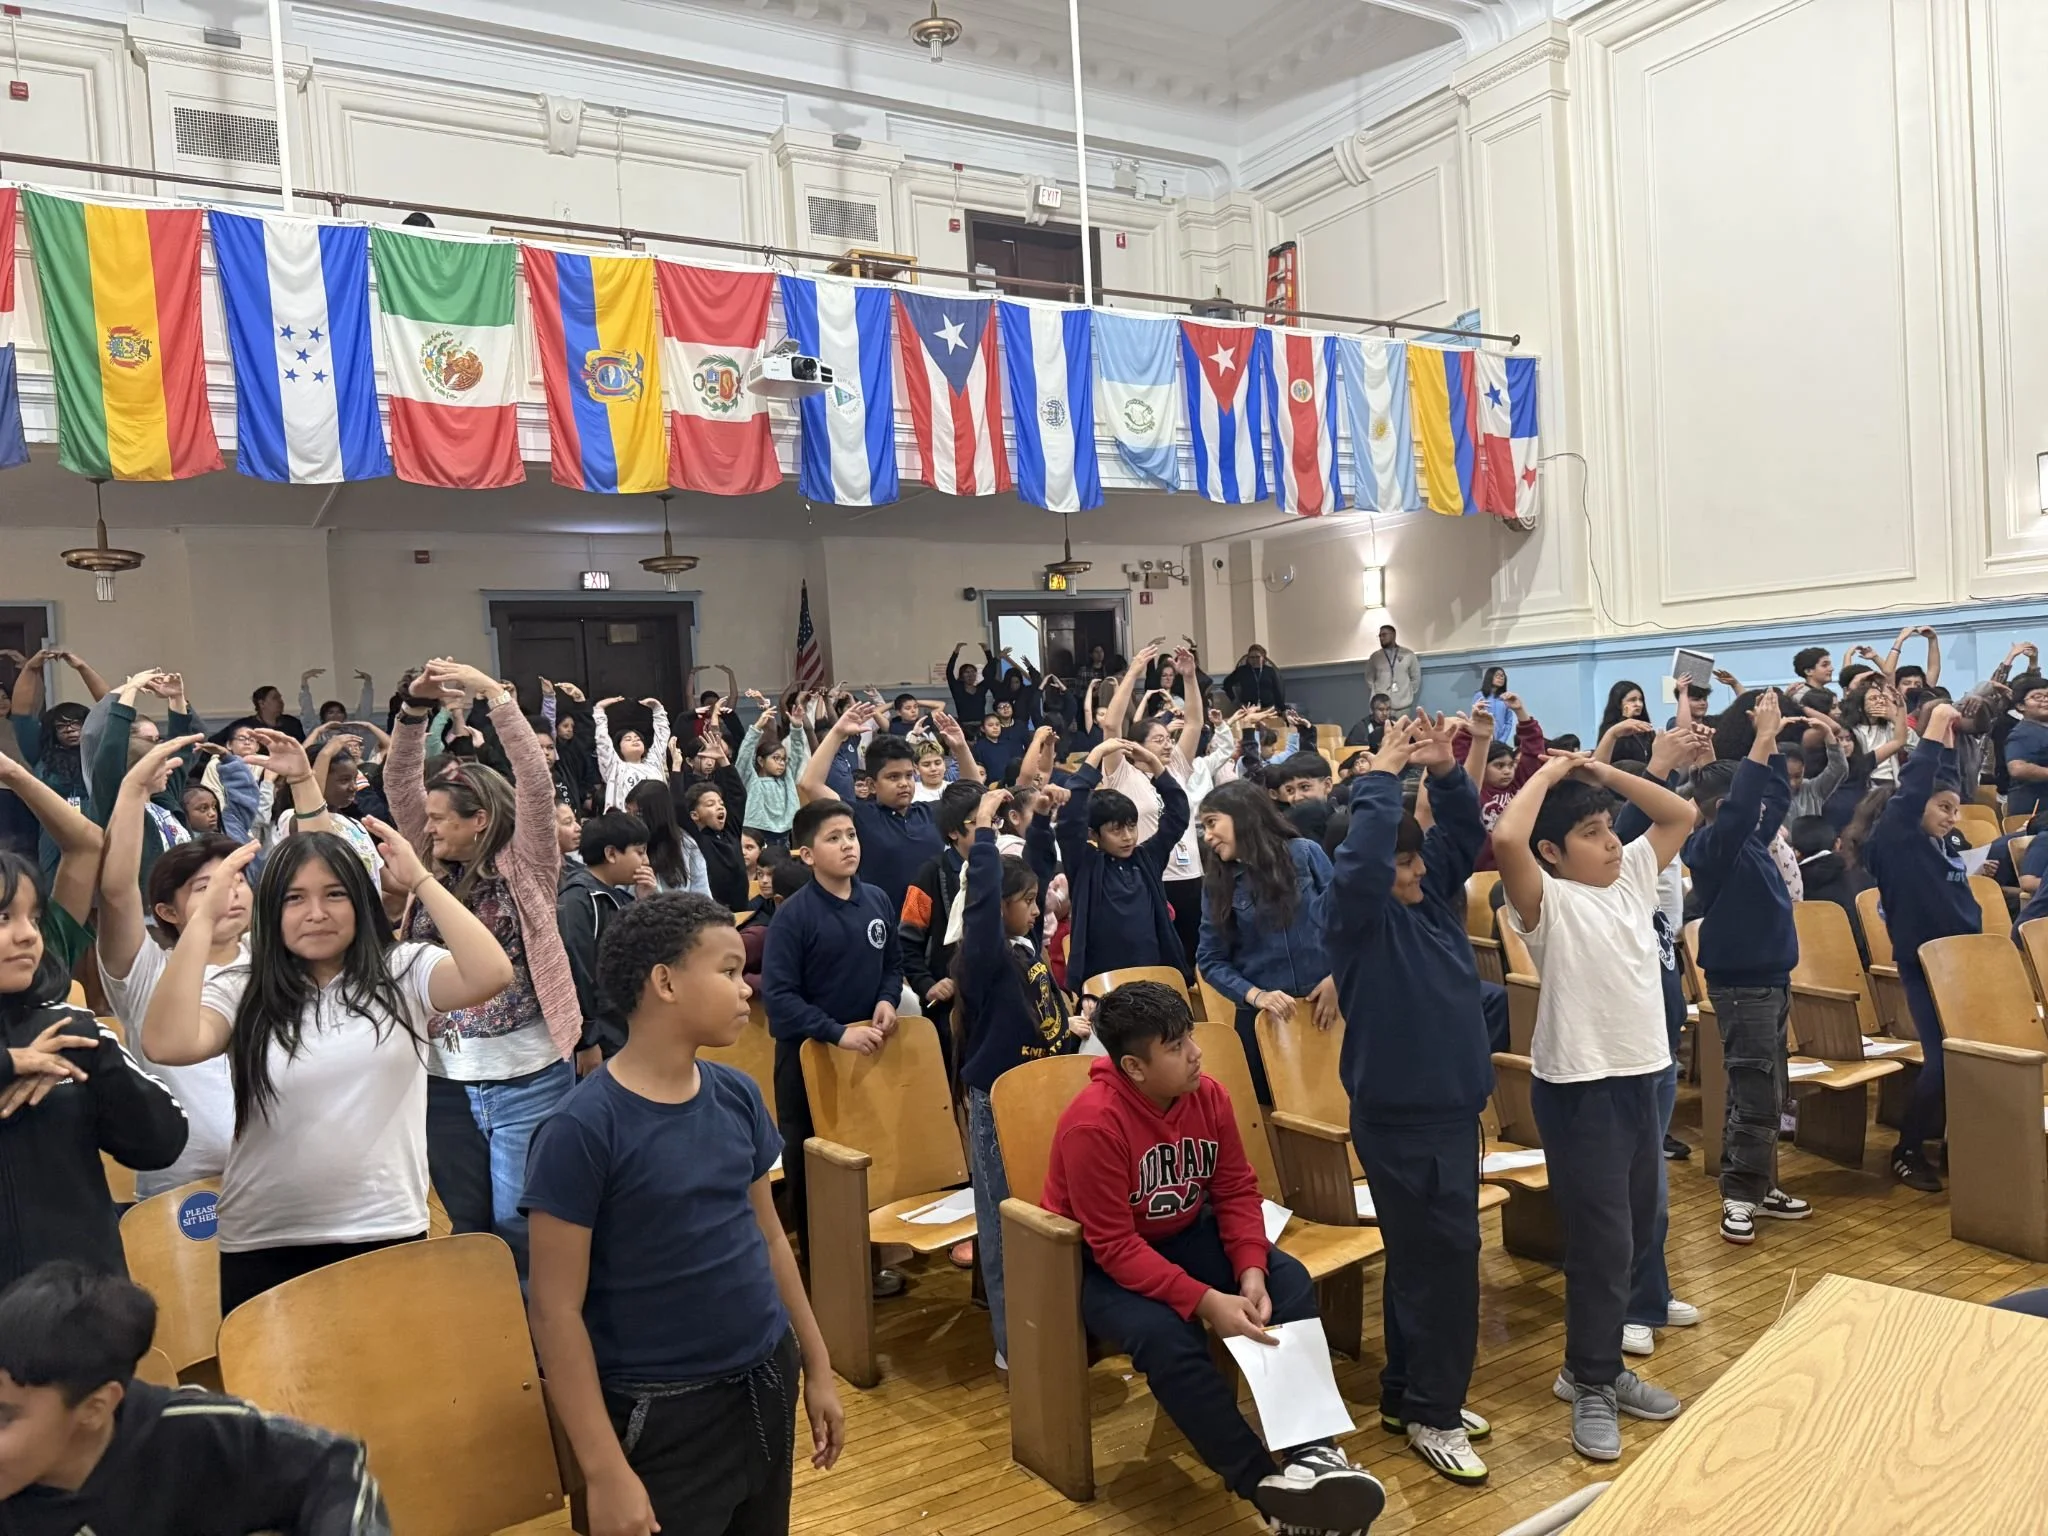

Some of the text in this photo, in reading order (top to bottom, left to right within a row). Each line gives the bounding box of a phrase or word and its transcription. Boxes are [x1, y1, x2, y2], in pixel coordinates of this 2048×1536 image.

[1042, 188, 1060, 205] EXIT
[583, 571, 607, 589] EXIT
[1051, 573, 1066, 589] EXI
[1128, 1137, 1218, 1206] JORAN
[183, 1212, 219, 1227] SIT HER
